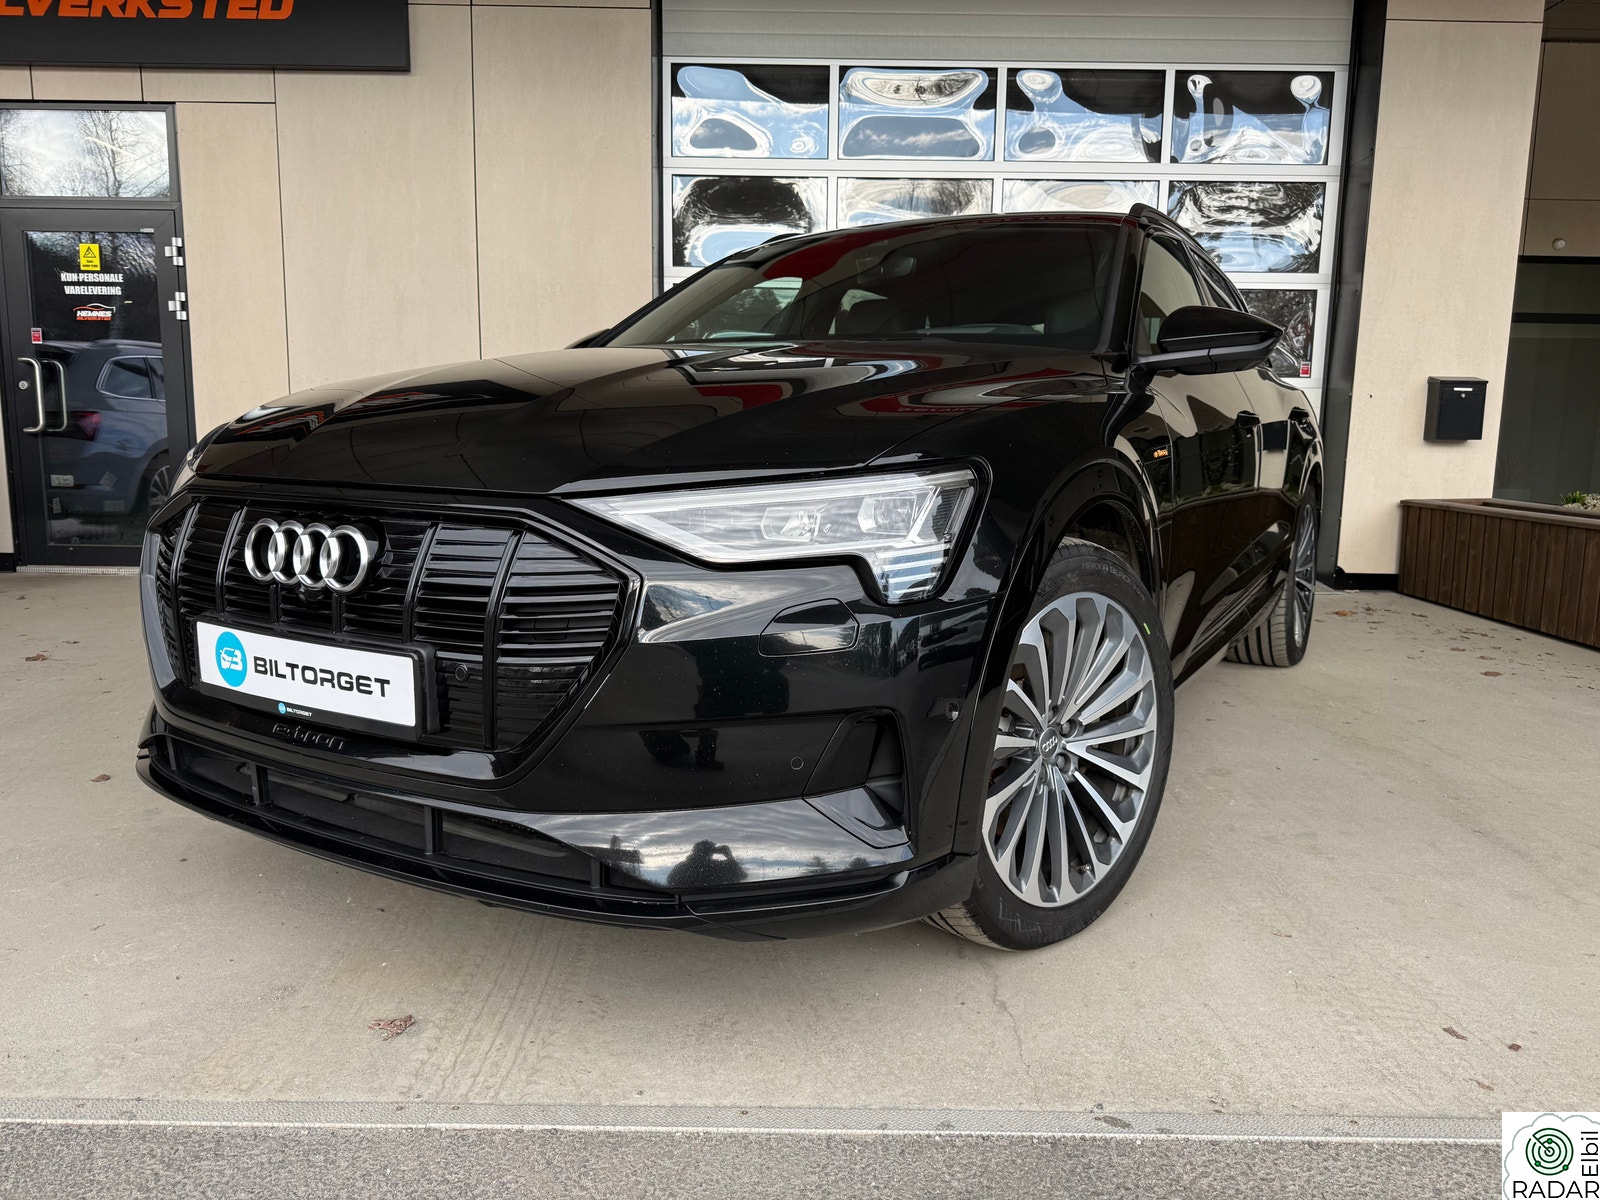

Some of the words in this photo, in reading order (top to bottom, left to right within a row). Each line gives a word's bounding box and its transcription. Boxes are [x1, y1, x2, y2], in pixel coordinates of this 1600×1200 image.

[60, 272, 78, 282] KUN
[78, 272, 124, 283] PERSONALE
[64, 285, 122, 295] VARELEVERING
[253, 656, 391, 698] BILTORGET
[286, 707, 313, 717] BILTORGET
